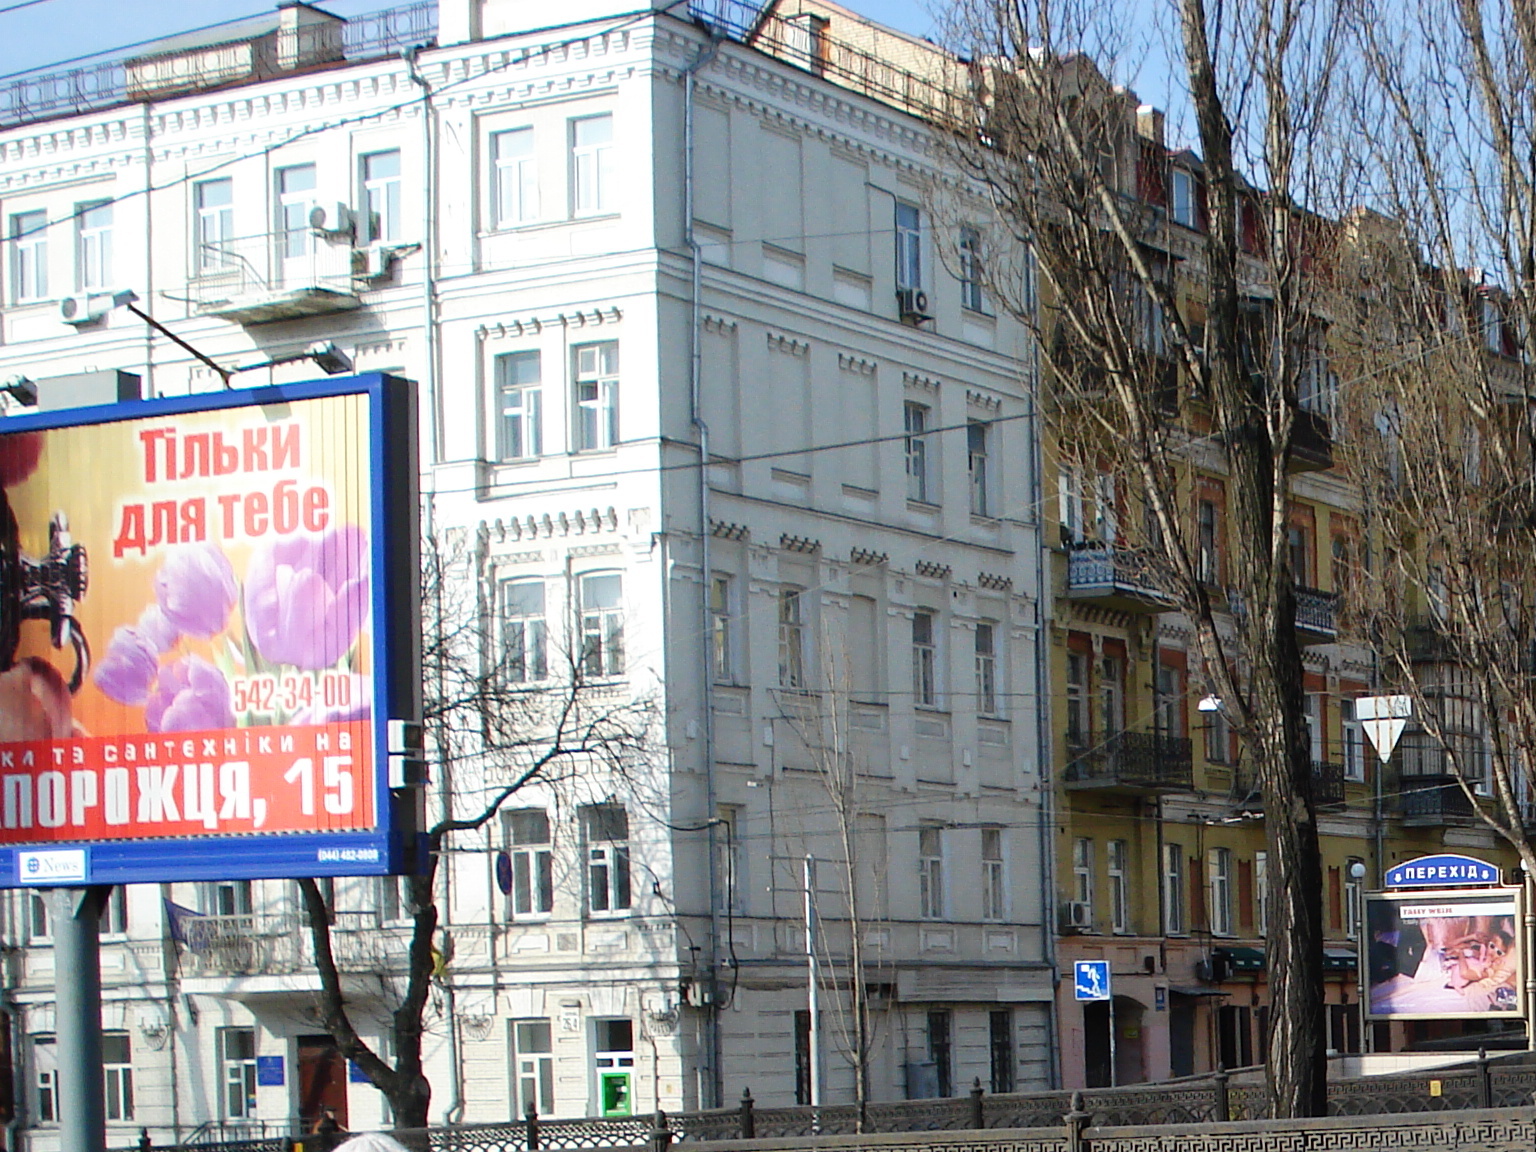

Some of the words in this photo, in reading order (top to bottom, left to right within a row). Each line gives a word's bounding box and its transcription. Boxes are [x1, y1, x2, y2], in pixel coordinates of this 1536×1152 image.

[140, 423, 300, 483] Тільки
[114, 497, 206, 558] для
[218, 479, 329, 539] тебе
[234, 673, 350, 714] 542-34-00
[53, 746, 85, 765] та
[316, 730, 352, 751] на
[0, 761, 267, 830] ПОРОЖЦЯ,
[283, 755, 354, 816] 15
[43, 857, 80, 873] News
[1405, 865, 1478, 880] ПЕРЕХІД
